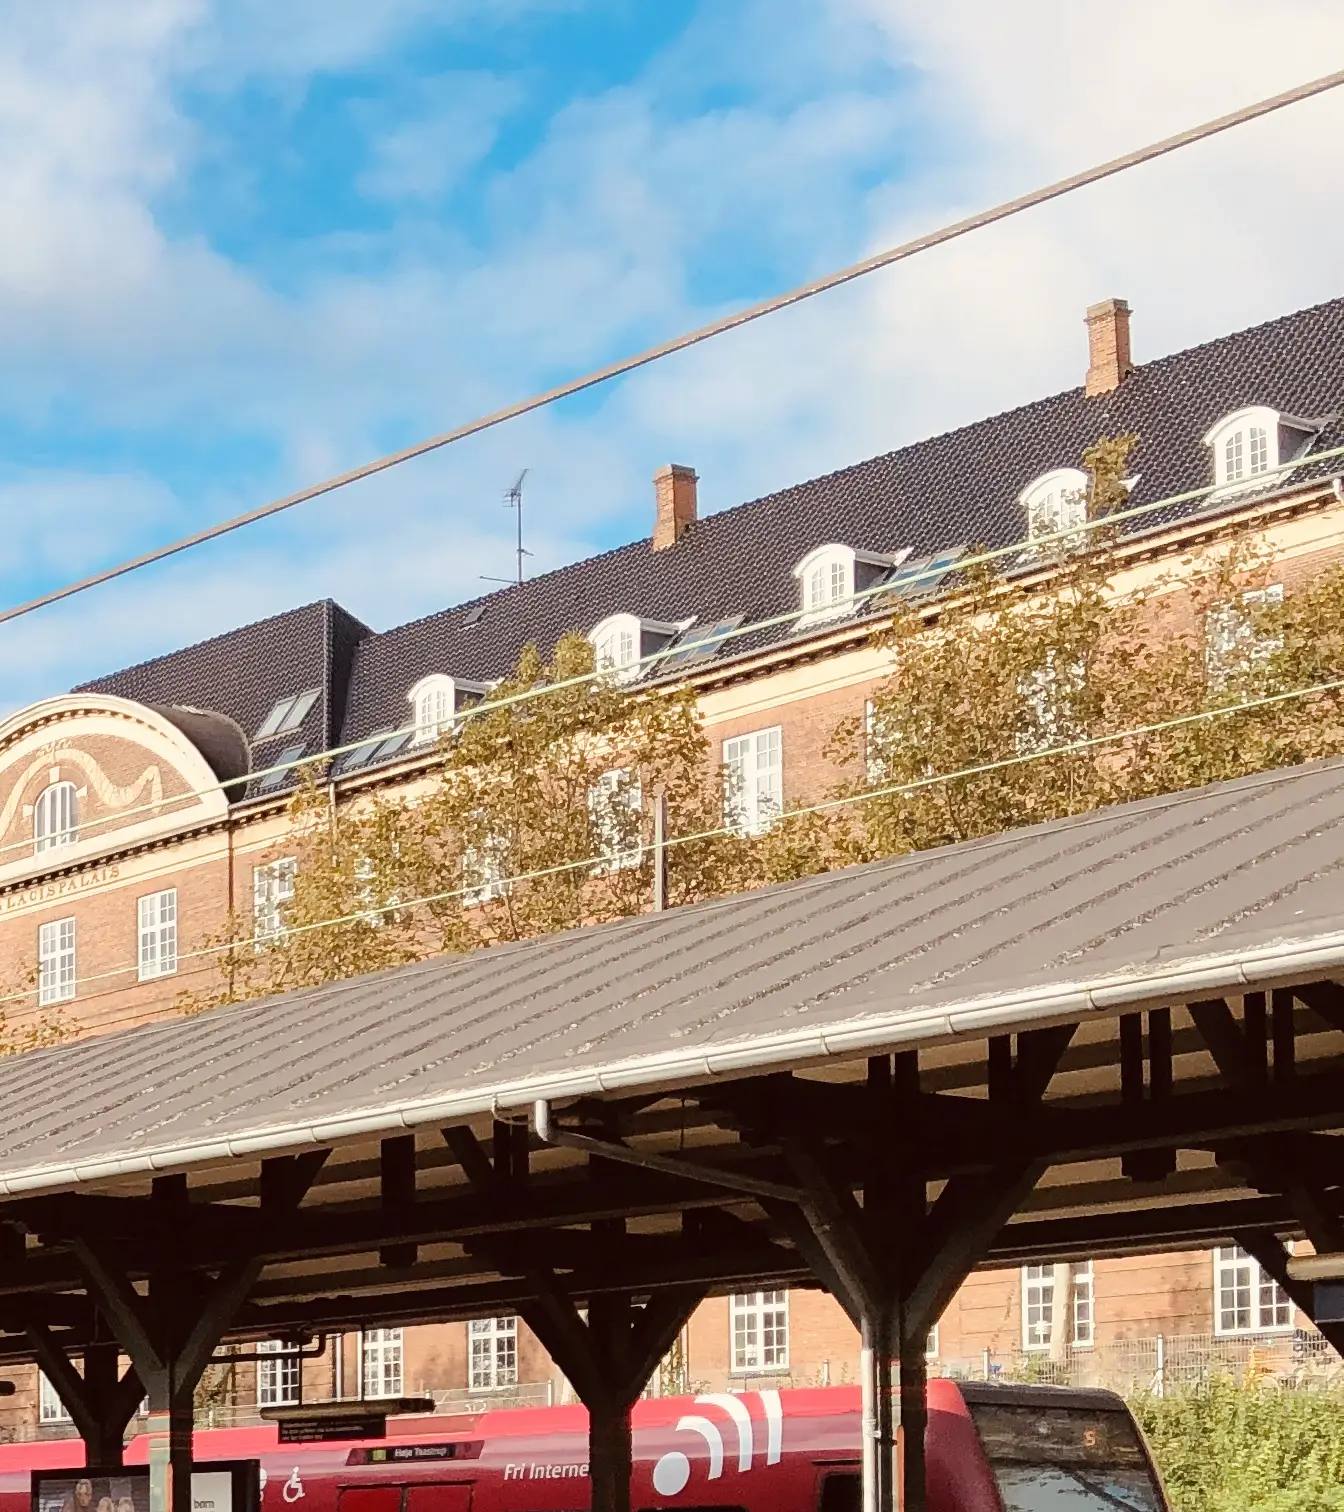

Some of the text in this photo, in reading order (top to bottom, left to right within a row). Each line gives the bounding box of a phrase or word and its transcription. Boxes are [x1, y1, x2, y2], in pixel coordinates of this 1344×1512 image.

[504, 1463, 590, 1481] Fri Interne
[193, 1499, 215, 1509] børn
